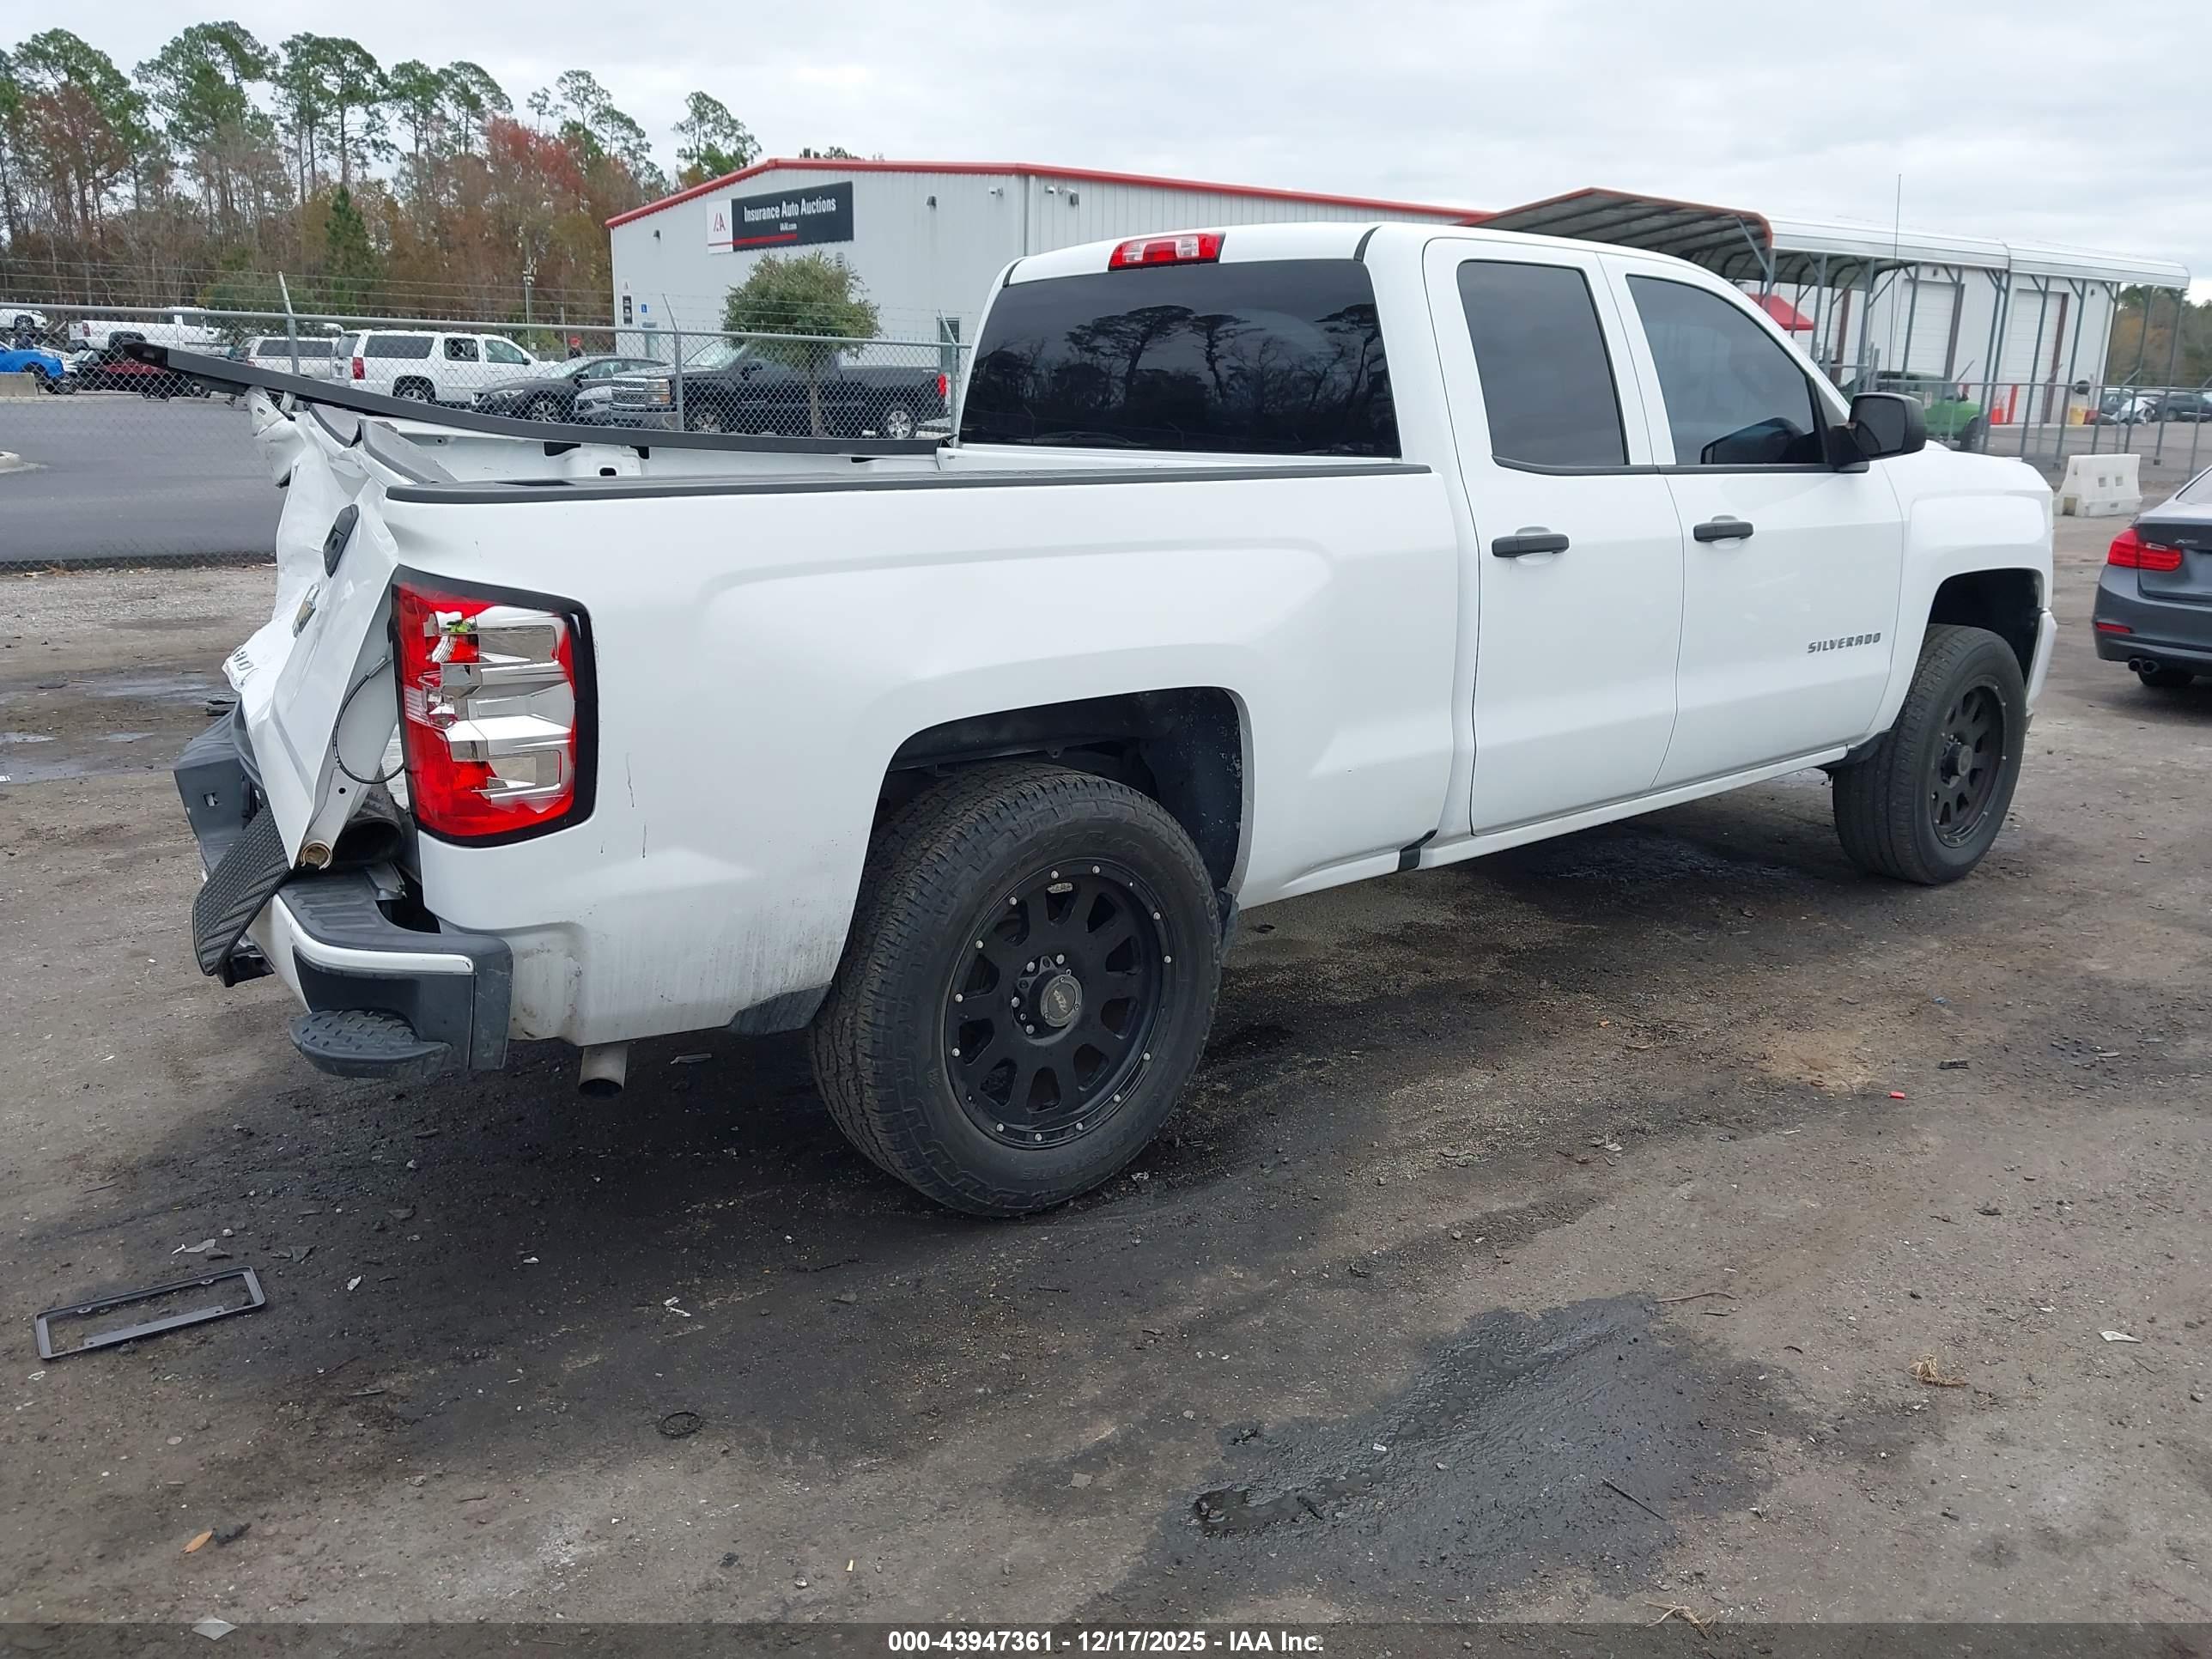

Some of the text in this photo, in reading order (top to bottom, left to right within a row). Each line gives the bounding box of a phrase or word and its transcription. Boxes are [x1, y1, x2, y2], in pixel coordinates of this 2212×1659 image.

[744, 196, 837, 223] Insurance Auto Auctions
[1807, 631, 1882, 654] SILVERADO
